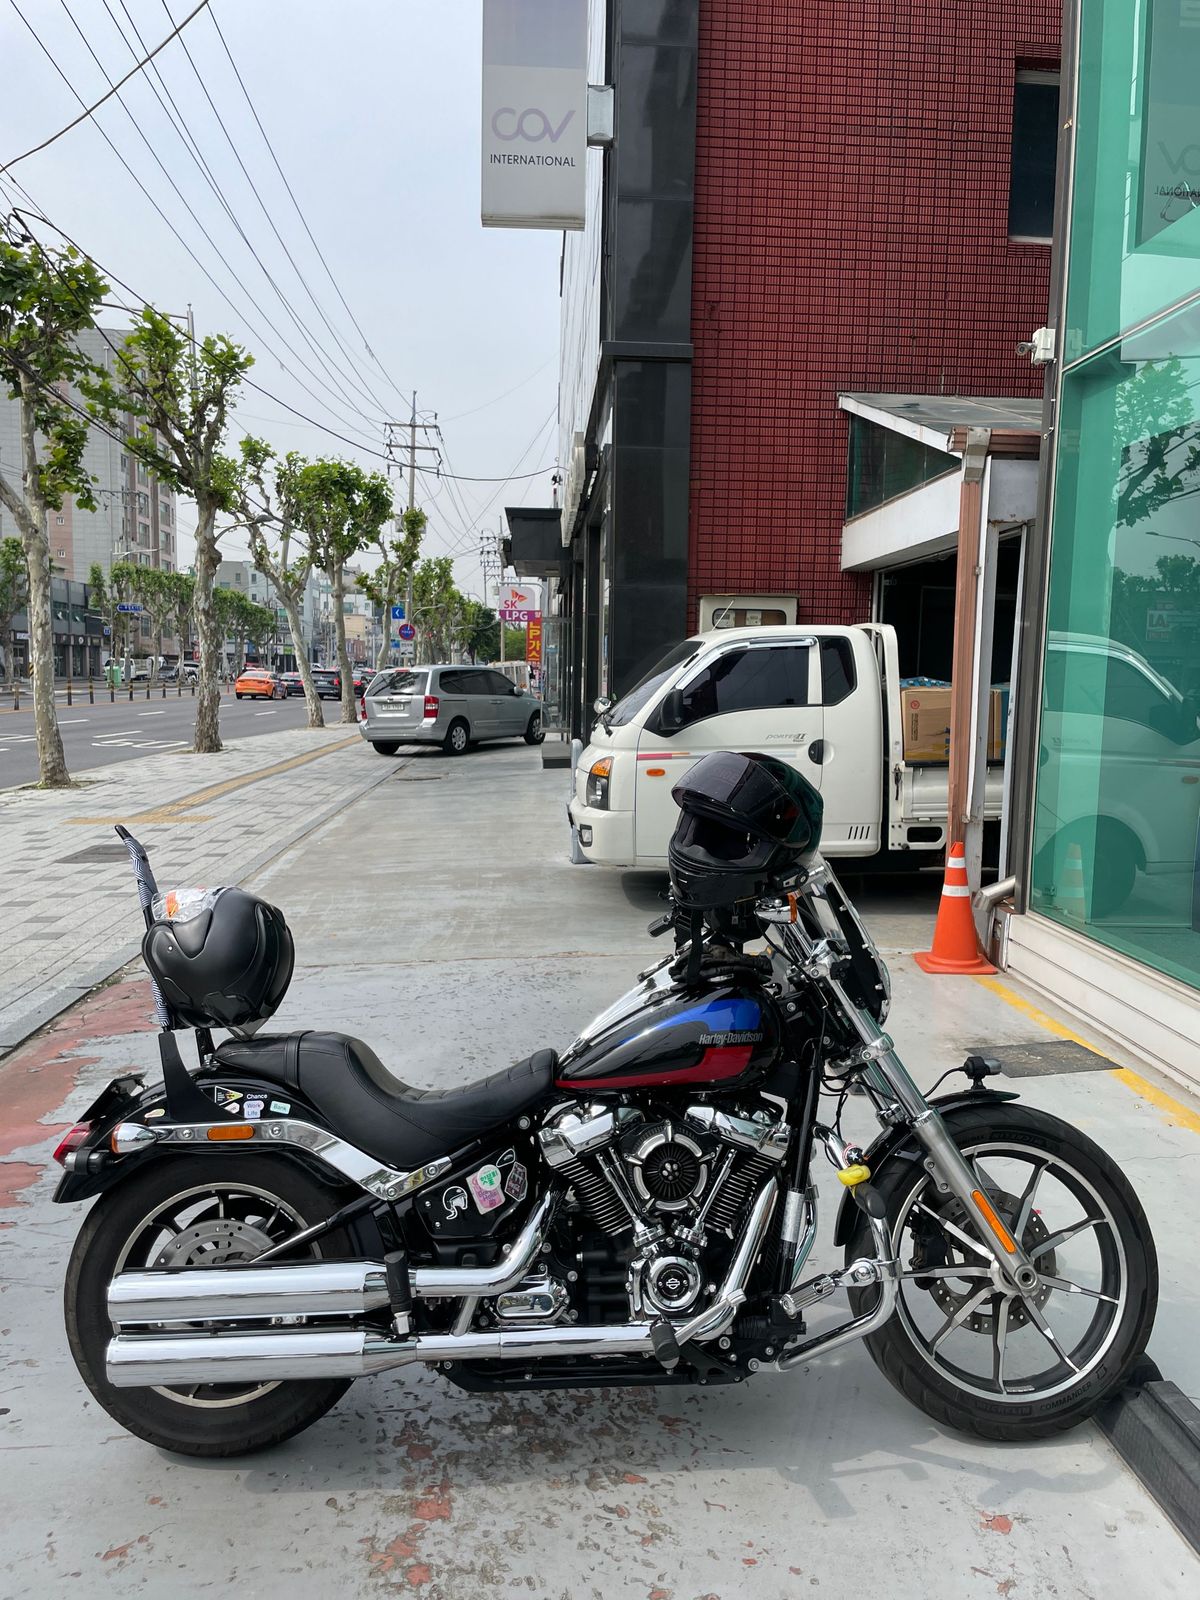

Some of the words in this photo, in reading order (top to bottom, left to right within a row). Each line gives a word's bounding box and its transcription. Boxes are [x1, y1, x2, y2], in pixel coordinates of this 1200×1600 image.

[491, 107, 576, 143] COV
[490, 154, 576, 167] INTERNATIONAL
[504, 600, 517, 609] SK
[506, 611, 528, 621] LPG
[699, 1031, 763, 1045] Harley-Davidson
[1040, 1381, 1092, 1411] COMMANDER
